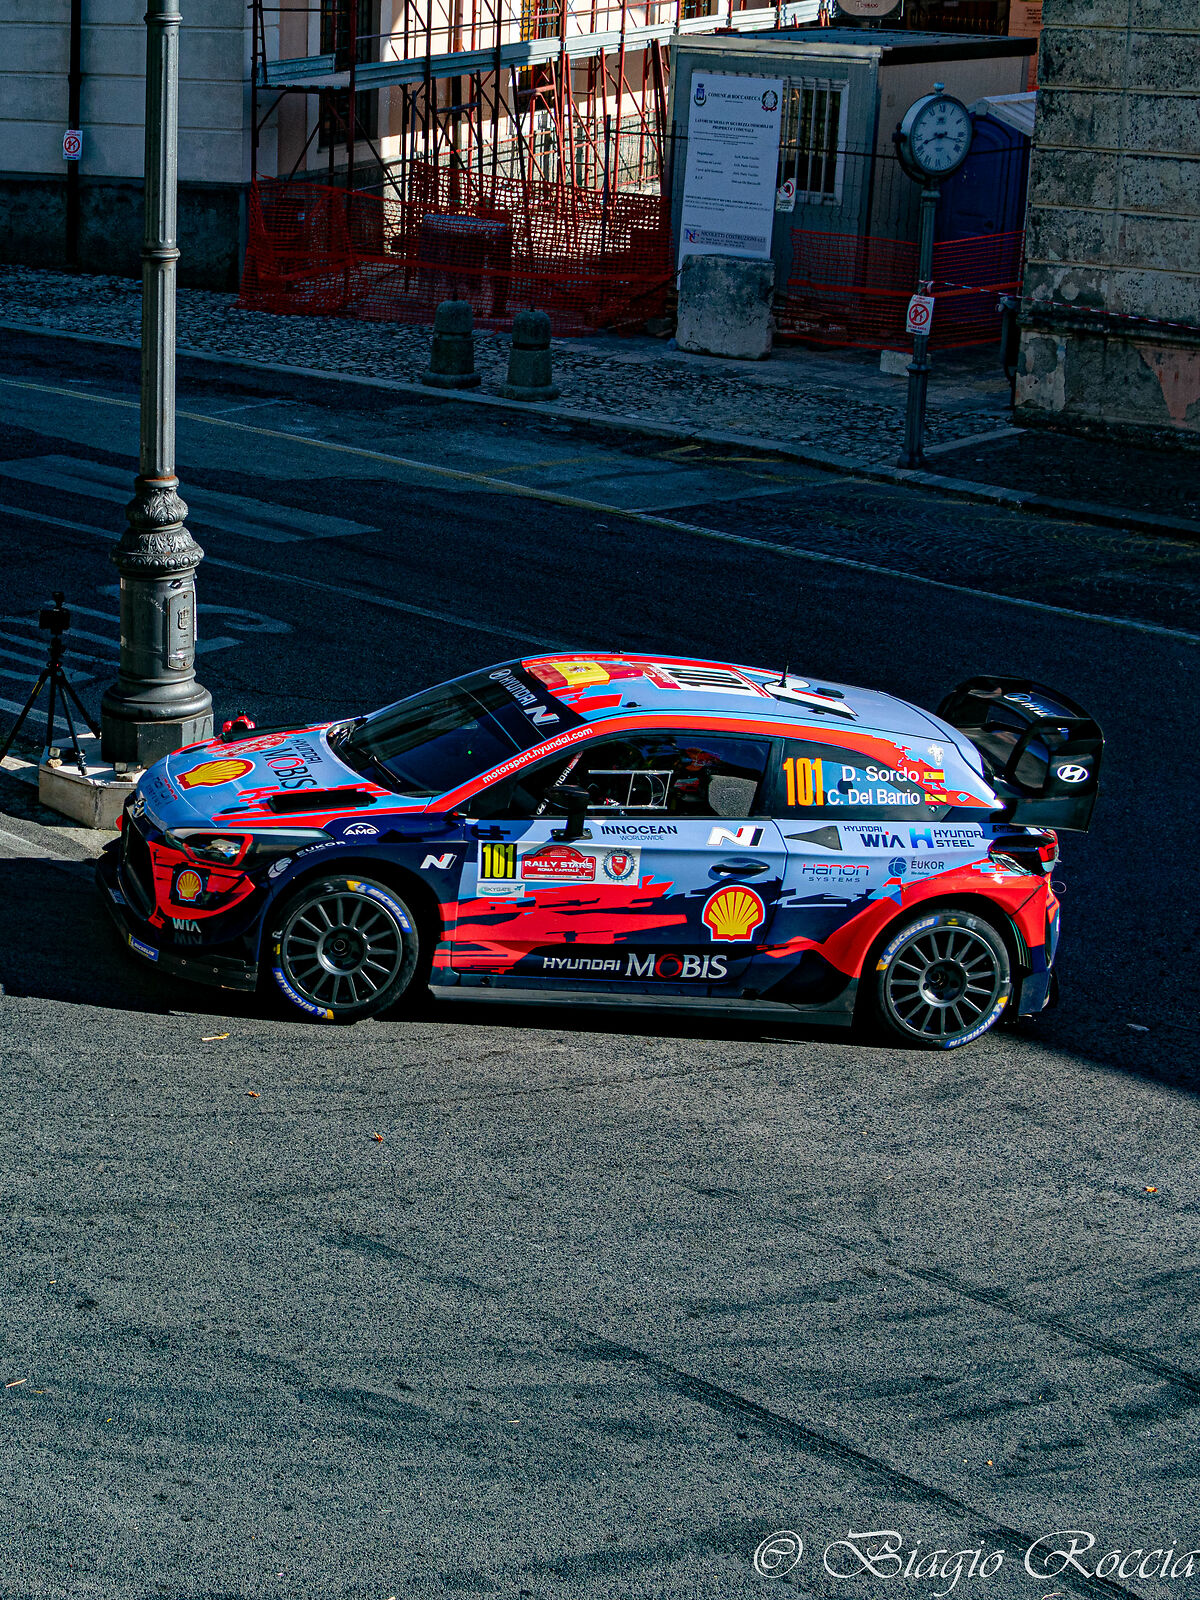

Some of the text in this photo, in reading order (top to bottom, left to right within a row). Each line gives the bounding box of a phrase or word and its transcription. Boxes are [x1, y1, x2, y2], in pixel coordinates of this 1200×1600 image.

[501, 674, 537, 707] HYUNDAI
[482, 726, 593, 783] motorsport.hyundai.com
[259, 748, 318, 789] MOBIS
[842, 766, 920, 782] D. Sordo
[783, 757, 824, 806] 101
[827, 788, 921, 805] C. Del Barrio
[601, 825, 678, 835] INNOCEAN
[843, 825, 883, 833] HYUNDAI
[933, 829, 985, 840] HYUNDAI
[296, 841, 346, 857] EUKOR
[935, 838, 976, 849] STEEL
[482, 843, 514, 880] 101
[524, 860, 593, 869] RALLY STARS
[910, 859, 945, 870] EUKOR
[366, 888, 410, 929] MICHELIN
[888, 916, 935, 953] MICHELIN
[543, 957, 620, 971] HYUNDAI
[625, 952, 728, 979] MOBIS
[274, 971, 316, 1013] MICHELIN
[949, 1013, 997, 1046] MICHELIN
